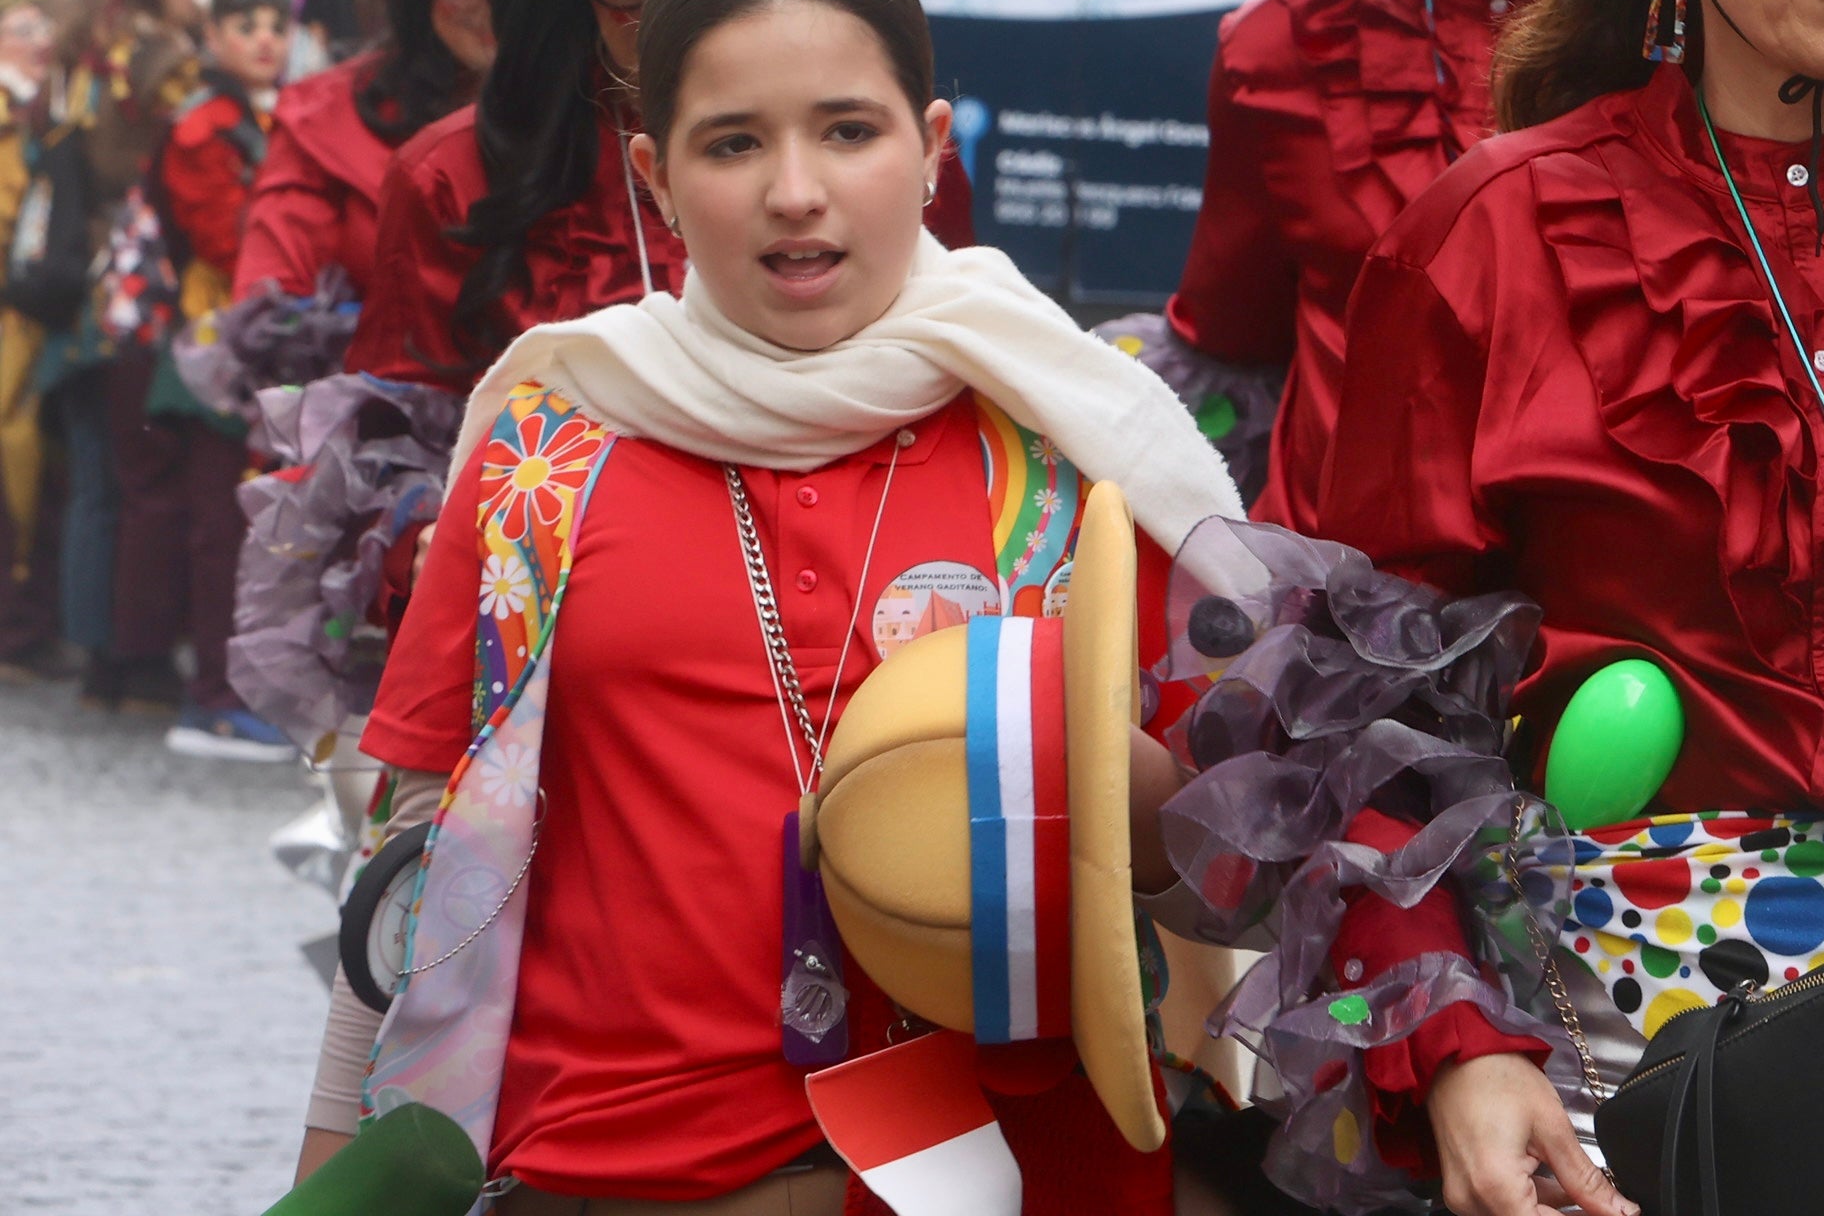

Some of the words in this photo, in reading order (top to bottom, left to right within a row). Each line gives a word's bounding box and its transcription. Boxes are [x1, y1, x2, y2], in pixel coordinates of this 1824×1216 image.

[899, 573, 968, 582] CAMPAMENTO
[970, 573, 983, 581] DE
[894, 584, 934, 592] VERANO
